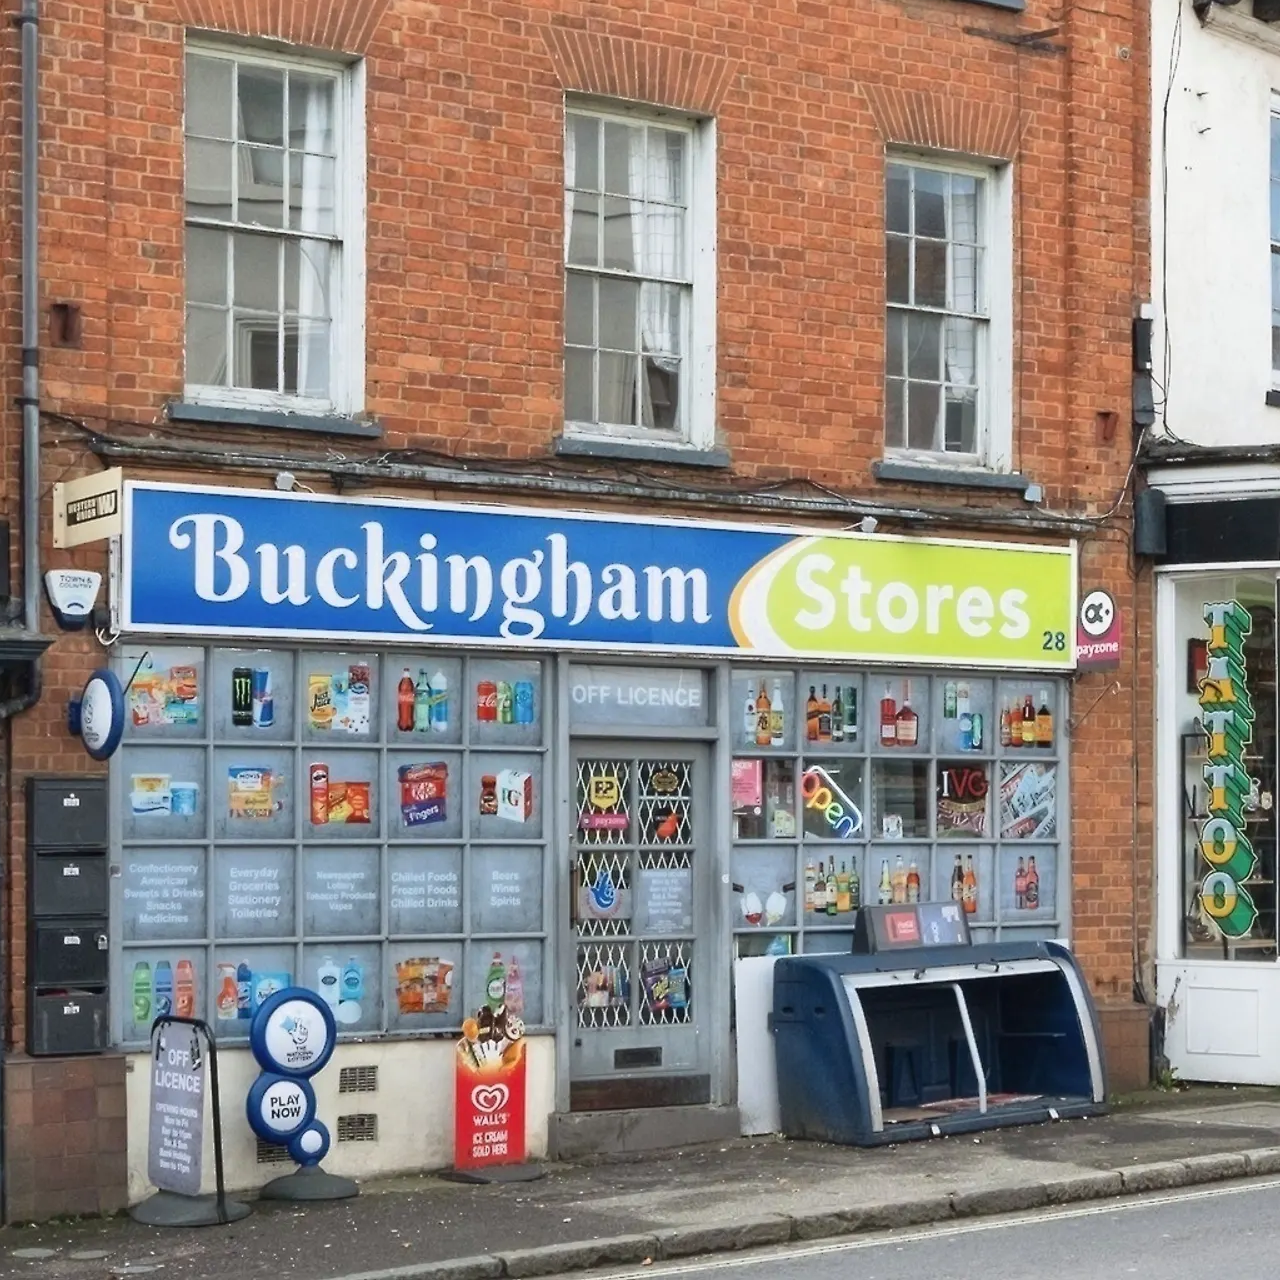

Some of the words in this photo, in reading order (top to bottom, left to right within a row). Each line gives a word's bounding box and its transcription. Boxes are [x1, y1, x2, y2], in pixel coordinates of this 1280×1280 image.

[168, 512, 713, 641] Buckingham
[793, 552, 1031, 639] Stores
[1042, 630, 1066, 651] 28
[1076, 641, 1119, 659] payzone
[572, 684, 611, 704] OFF
[617, 686, 702, 707] LICENCE
[1199, 600, 1257, 937] TATTOO
[942, 768, 988, 798] IVG
[230, 868, 279, 880] Everyday
[391, 872, 425, 882] Chilled
[427, 872, 457, 882] Foods
[492, 871, 519, 881] Beers
[140, 876, 188, 886] American
[228, 881, 280, 892] Groceries
[327, 882, 355, 891] Lottery
[124, 888, 159, 898] Sweets
[172, 888, 204, 898] Drinks
[391, 885, 425, 895] Frozen
[427, 885, 457, 895] Foods
[491, 884, 520, 893] Wines
[227, 894, 281, 906] Stationery
[340, 891, 376, 900] Products
[490, 896, 521, 907] Spirits
[146, 900, 183, 911] Snacks
[391, 898, 425, 908] Chilled
[427, 898, 459, 908] Drinks
[139, 913, 189, 923] Medicines
[231, 908, 279, 918] Toiletries
[167, 1049, 190, 1067] OFF
[155, 1070, 201, 1093] LICENCE
[270, 1093, 300, 1107] PLAY
[155, 1102, 179, 1115] OPENING
[180, 1107, 198, 1118] HOURS
[271, 1106, 301, 1119] NOW
[473, 1132, 483, 1144] ICE
[484, 1130, 508, 1142] CREAM
[472, 1145, 491, 1158] SOLD
